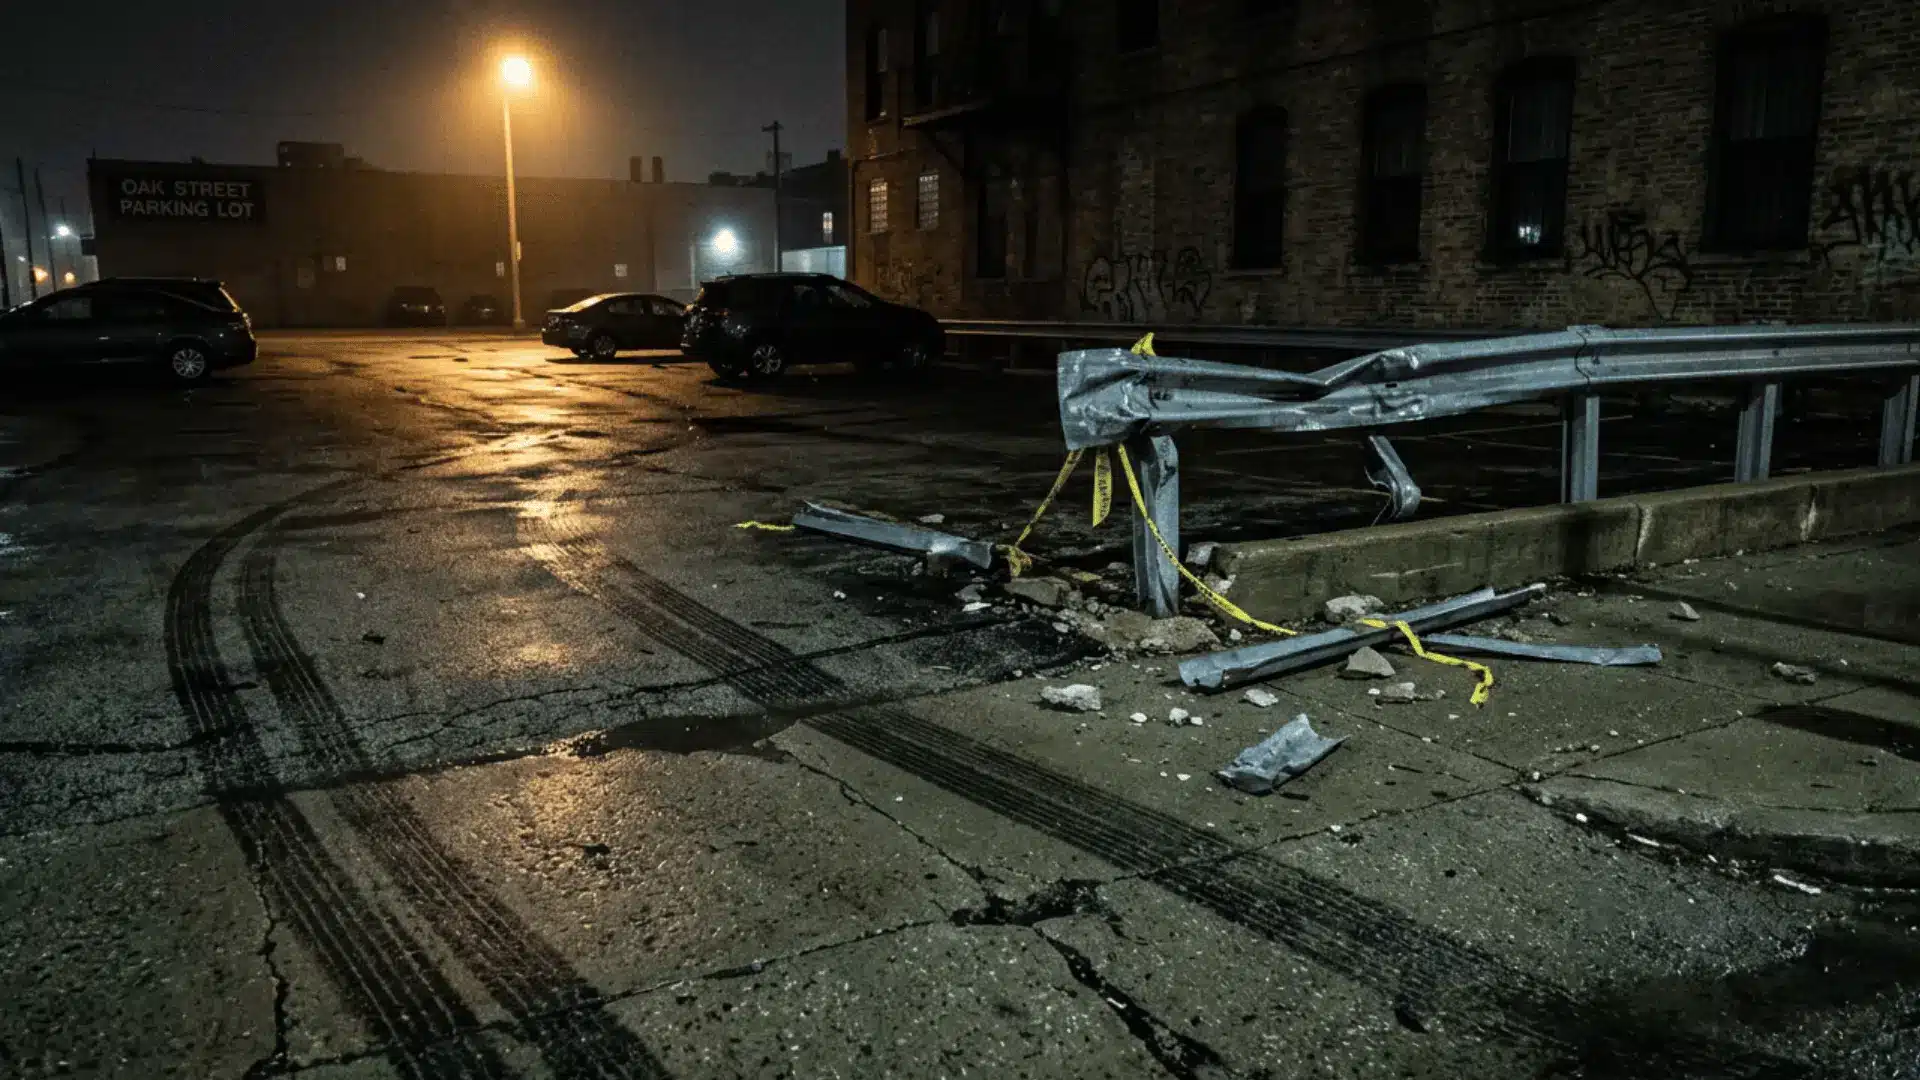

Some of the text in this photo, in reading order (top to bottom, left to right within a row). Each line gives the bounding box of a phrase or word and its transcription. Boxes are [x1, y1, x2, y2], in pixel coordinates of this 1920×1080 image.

[121, 178, 252, 197] OAK STREET
[120, 199, 255, 218] PARKING LOT
